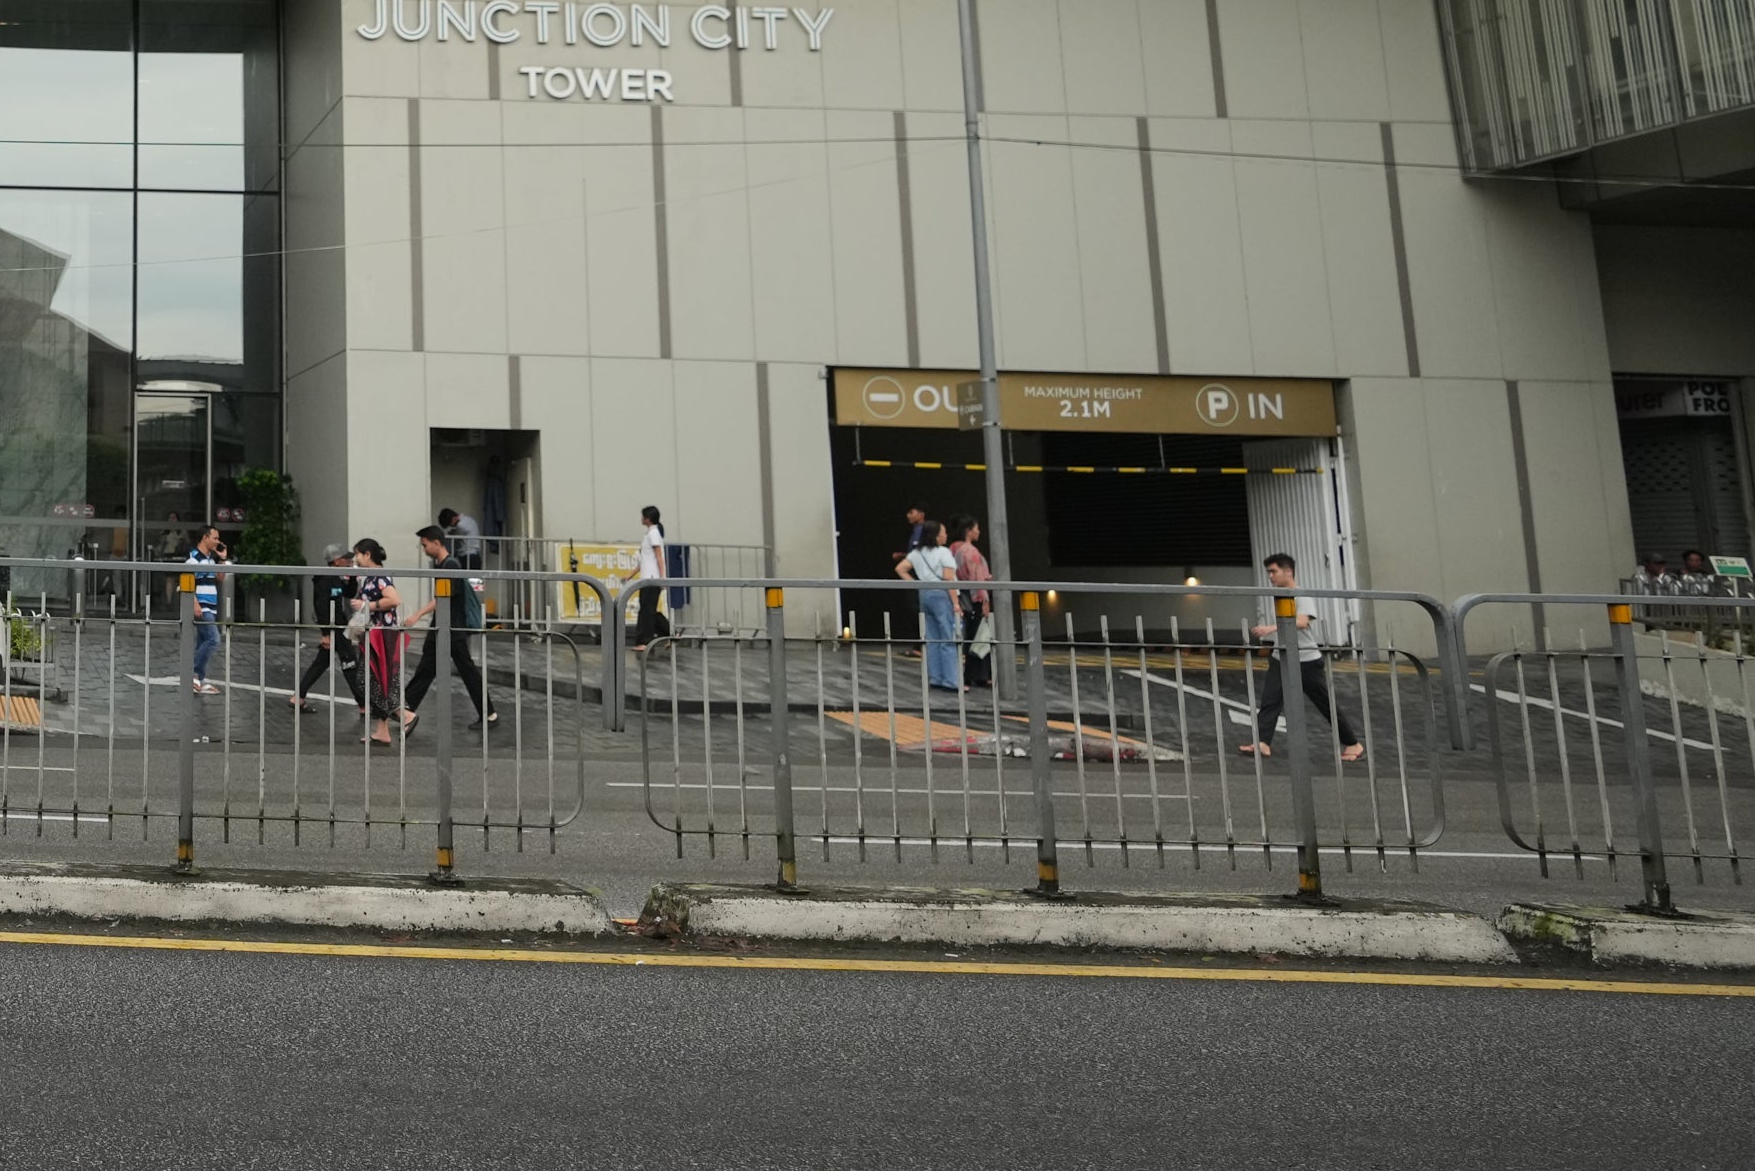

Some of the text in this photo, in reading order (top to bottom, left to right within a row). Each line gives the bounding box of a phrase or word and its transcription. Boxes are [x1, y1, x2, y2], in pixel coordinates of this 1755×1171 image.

[690, 5, 835, 51] CITY
[519, 66, 675, 102] TOWER
[913, 384, 959, 413] OU
[1024, 386, 1144, 400] MAXIMUM HEIGHT
[1207, 390, 1284, 421] P IN
[1059, 399, 1112, 418] 2.1M
